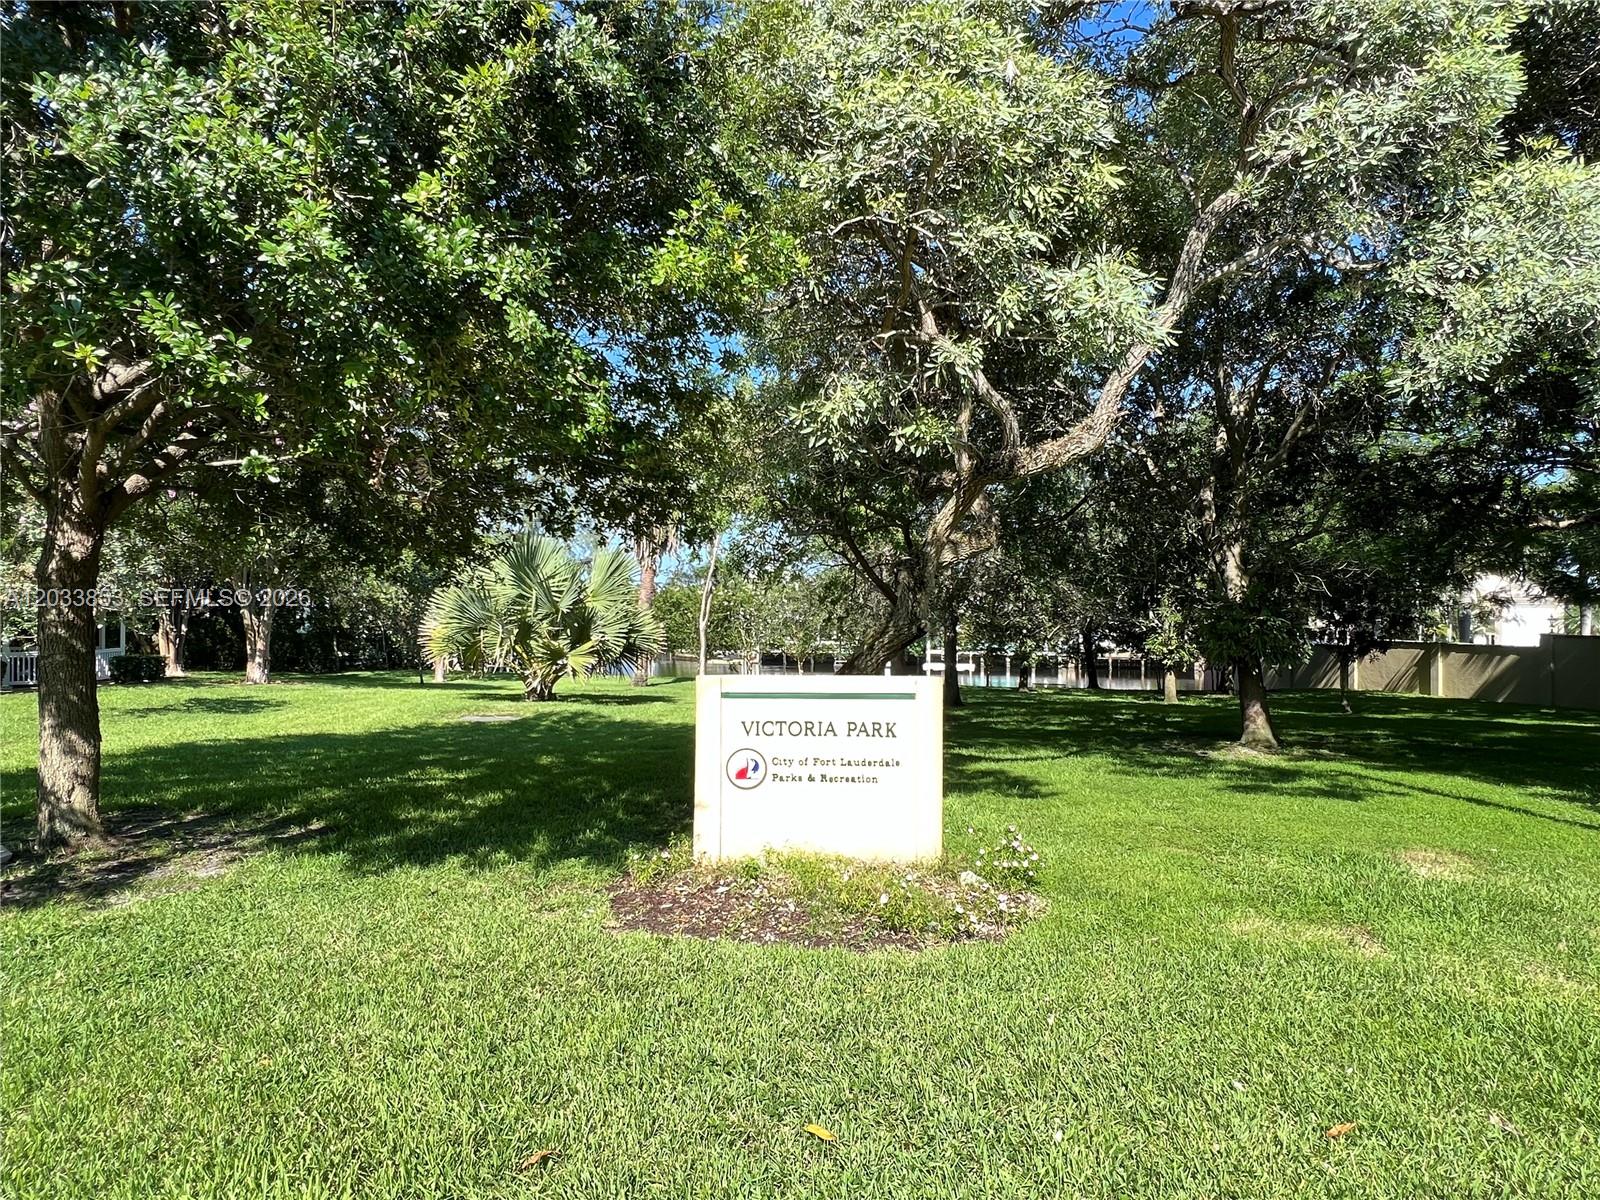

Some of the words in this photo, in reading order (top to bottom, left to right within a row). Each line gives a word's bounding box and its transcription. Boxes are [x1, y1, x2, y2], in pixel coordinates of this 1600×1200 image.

[741, 720, 838, 737] VICTORIA
[846, 721, 897, 738] PARK
[771, 757, 794, 768] City
[798, 757, 809, 767] of
[813, 757, 836, 767] Fort
[840, 757, 901, 768] Lauderdale
[771, 773, 803, 783] Parks
[807, 774, 816, 783] &
[820, 774, 878, 784] Recreation
